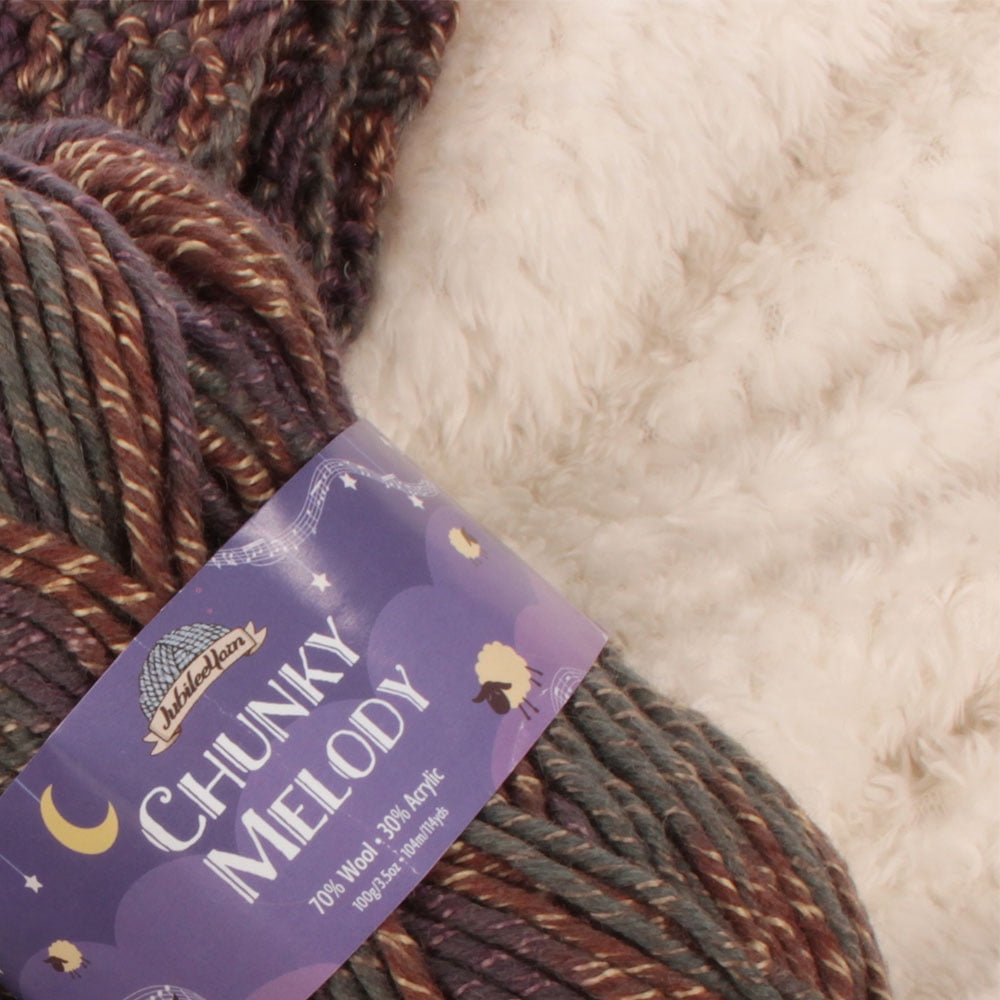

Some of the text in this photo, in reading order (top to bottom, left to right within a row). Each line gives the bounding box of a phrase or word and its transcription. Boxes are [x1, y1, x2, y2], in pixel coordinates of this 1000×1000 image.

[139, 615, 360, 852] CHUNKY
[203, 664, 430, 904] MELODY
[308, 767, 445, 914] 70% Wool 30% Acrylic
[351, 807, 449, 912] 100g/3.5oz 104m/114yds
